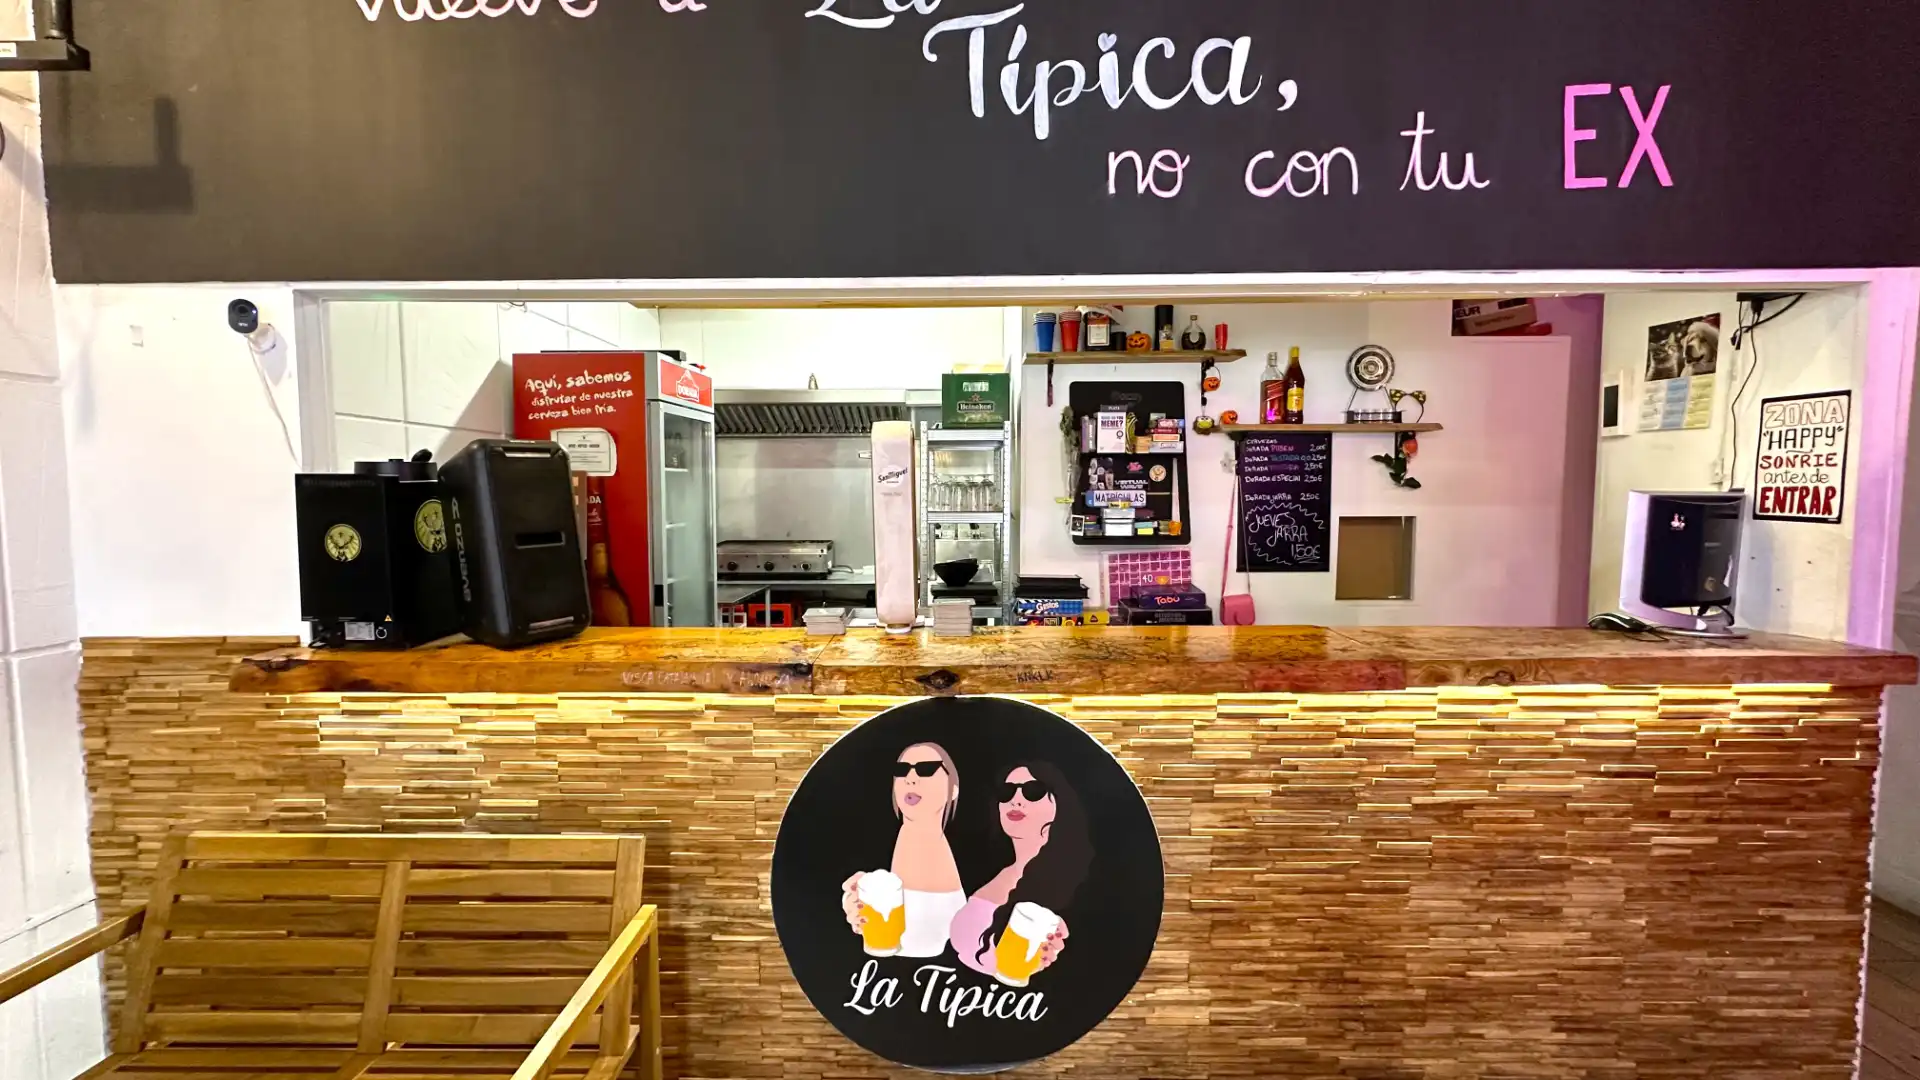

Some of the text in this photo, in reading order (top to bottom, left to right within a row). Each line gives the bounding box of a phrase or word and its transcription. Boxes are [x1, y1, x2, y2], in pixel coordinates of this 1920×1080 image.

[922, 2, 1298, 140] Típica,
[1106, 84, 1674, 199] no con tu EX
[525, 370, 632, 397] Aquí, sabemos
[531, 388, 634, 407] disfrutar de nuestra
[528, 407, 569, 420] cerveza
[571, 404, 592, 416] bien
[1100, 420, 1124, 428] MEME?
[1764, 399, 1844, 429] ZONA
[1763, 468, 1830, 484] antes de
[1759, 485, 1837, 516] ENTRAR
[1142, 574, 1154, 584] 40
[843, 959, 1049, 1028] La Típica
